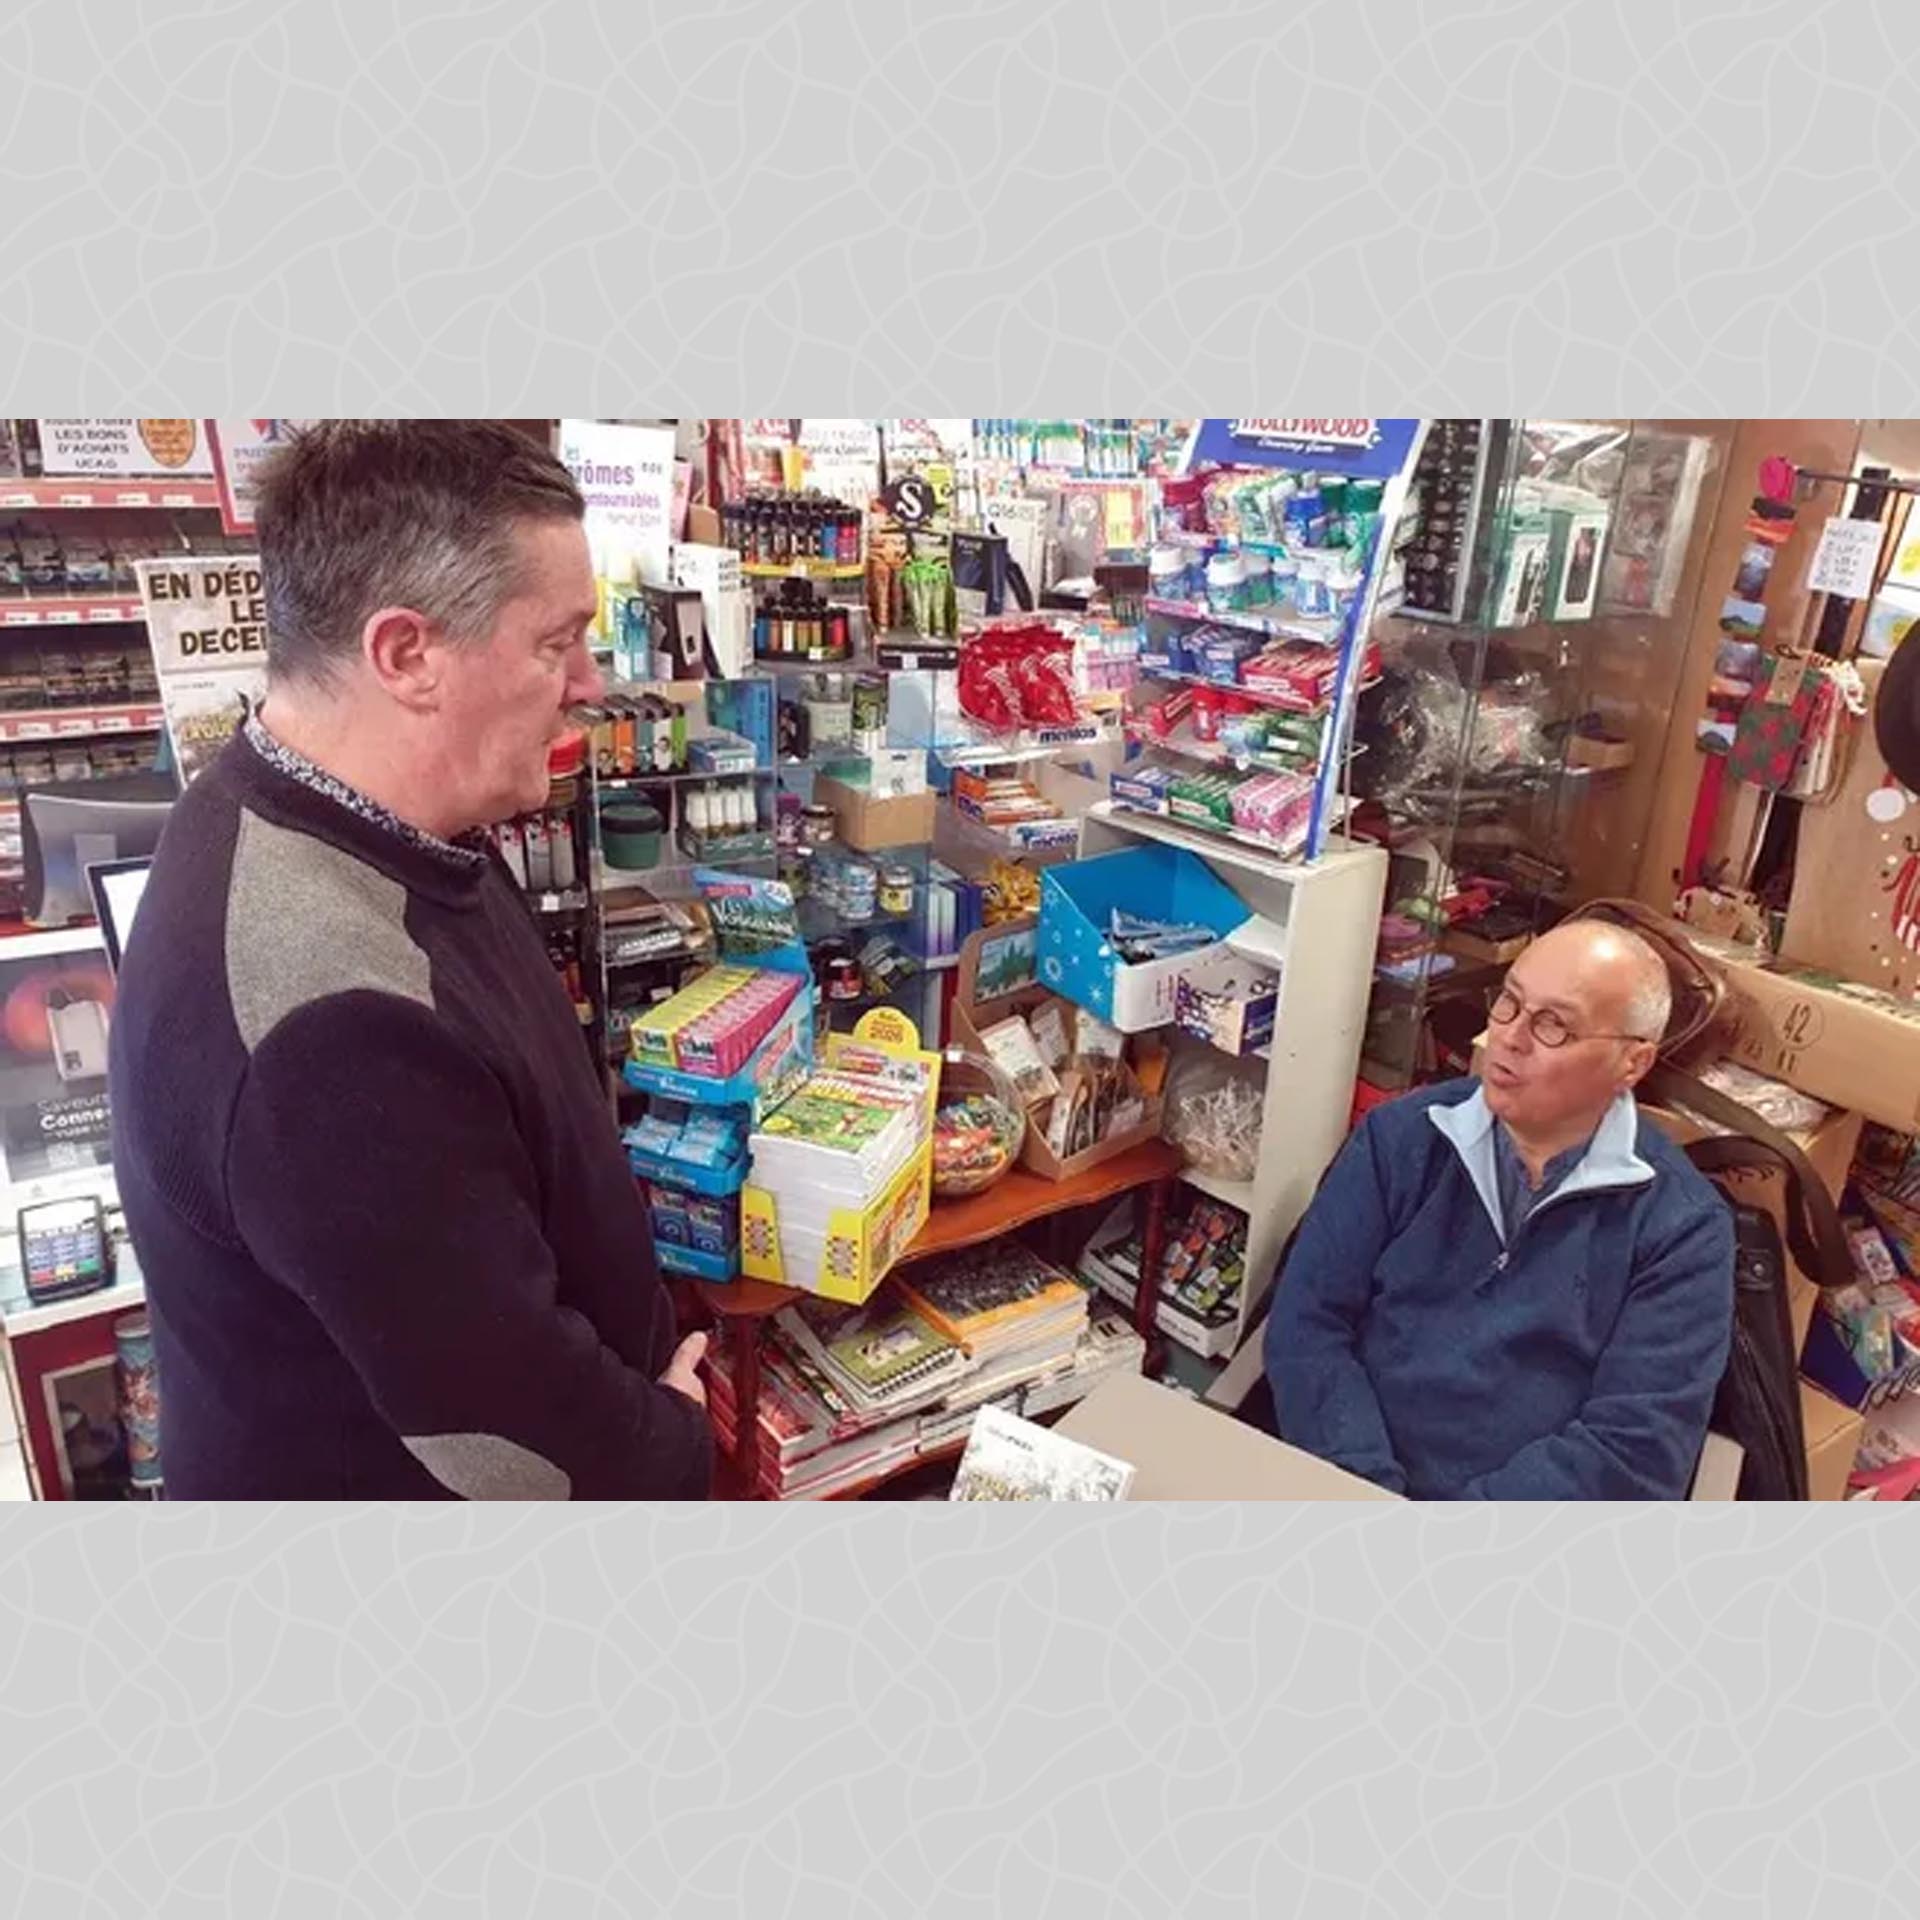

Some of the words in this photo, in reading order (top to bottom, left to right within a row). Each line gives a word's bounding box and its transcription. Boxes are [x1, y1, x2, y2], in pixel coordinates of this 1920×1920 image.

[54, 429, 85, 441] LES
[86, 428, 128, 441] BONS
[57, 442, 130, 455] D'ACHATS
[149, 572, 192, 600] EN
[203, 562, 262, 598] DÉD
[230, 600, 266, 624] LE
[180, 626, 267, 656] DECE
[1039, 727, 1097, 744] mentos
[1782, 1002, 1811, 1044] 42
